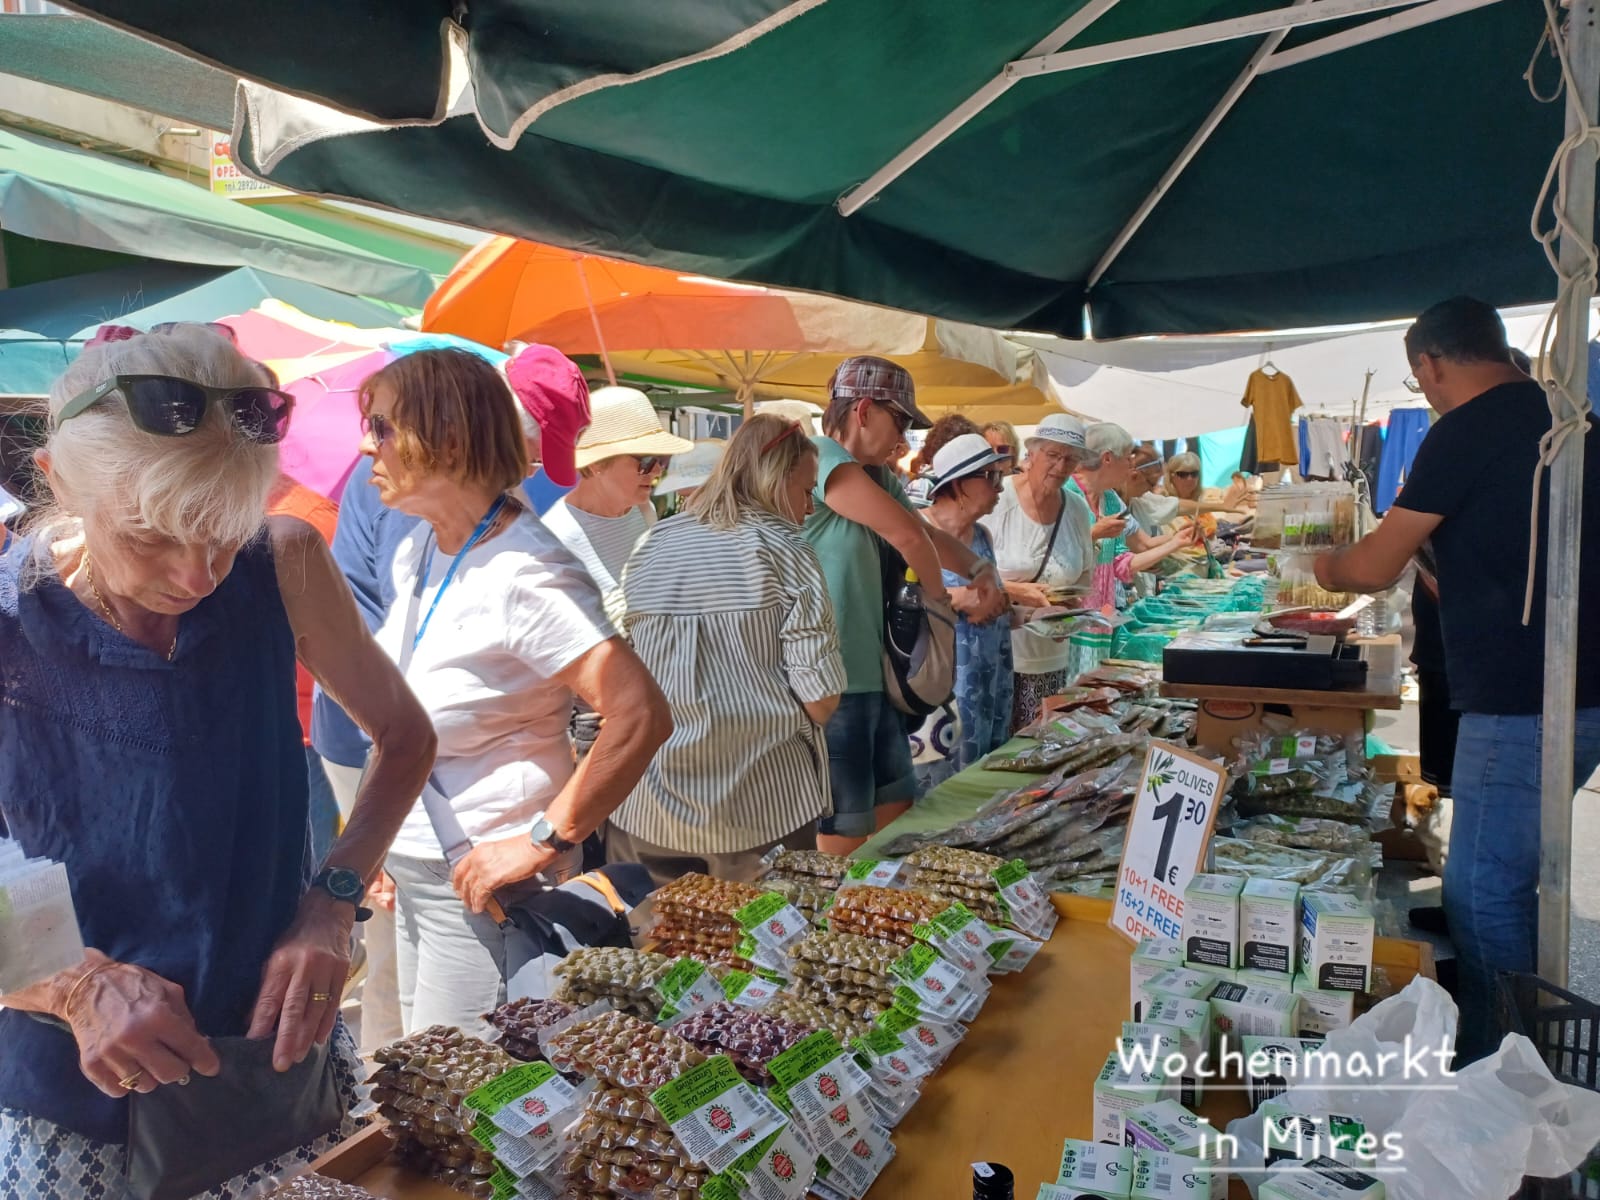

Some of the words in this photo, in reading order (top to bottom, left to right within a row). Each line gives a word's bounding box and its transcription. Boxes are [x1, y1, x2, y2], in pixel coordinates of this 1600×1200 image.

[1177, 769, 1214, 797] OLIVES
[1120, 887, 1145, 917] 15+2
[1145, 905, 1181, 940] FREE
[1124, 866, 1149, 895] 10+1
[1150, 883, 1185, 919] FREE
